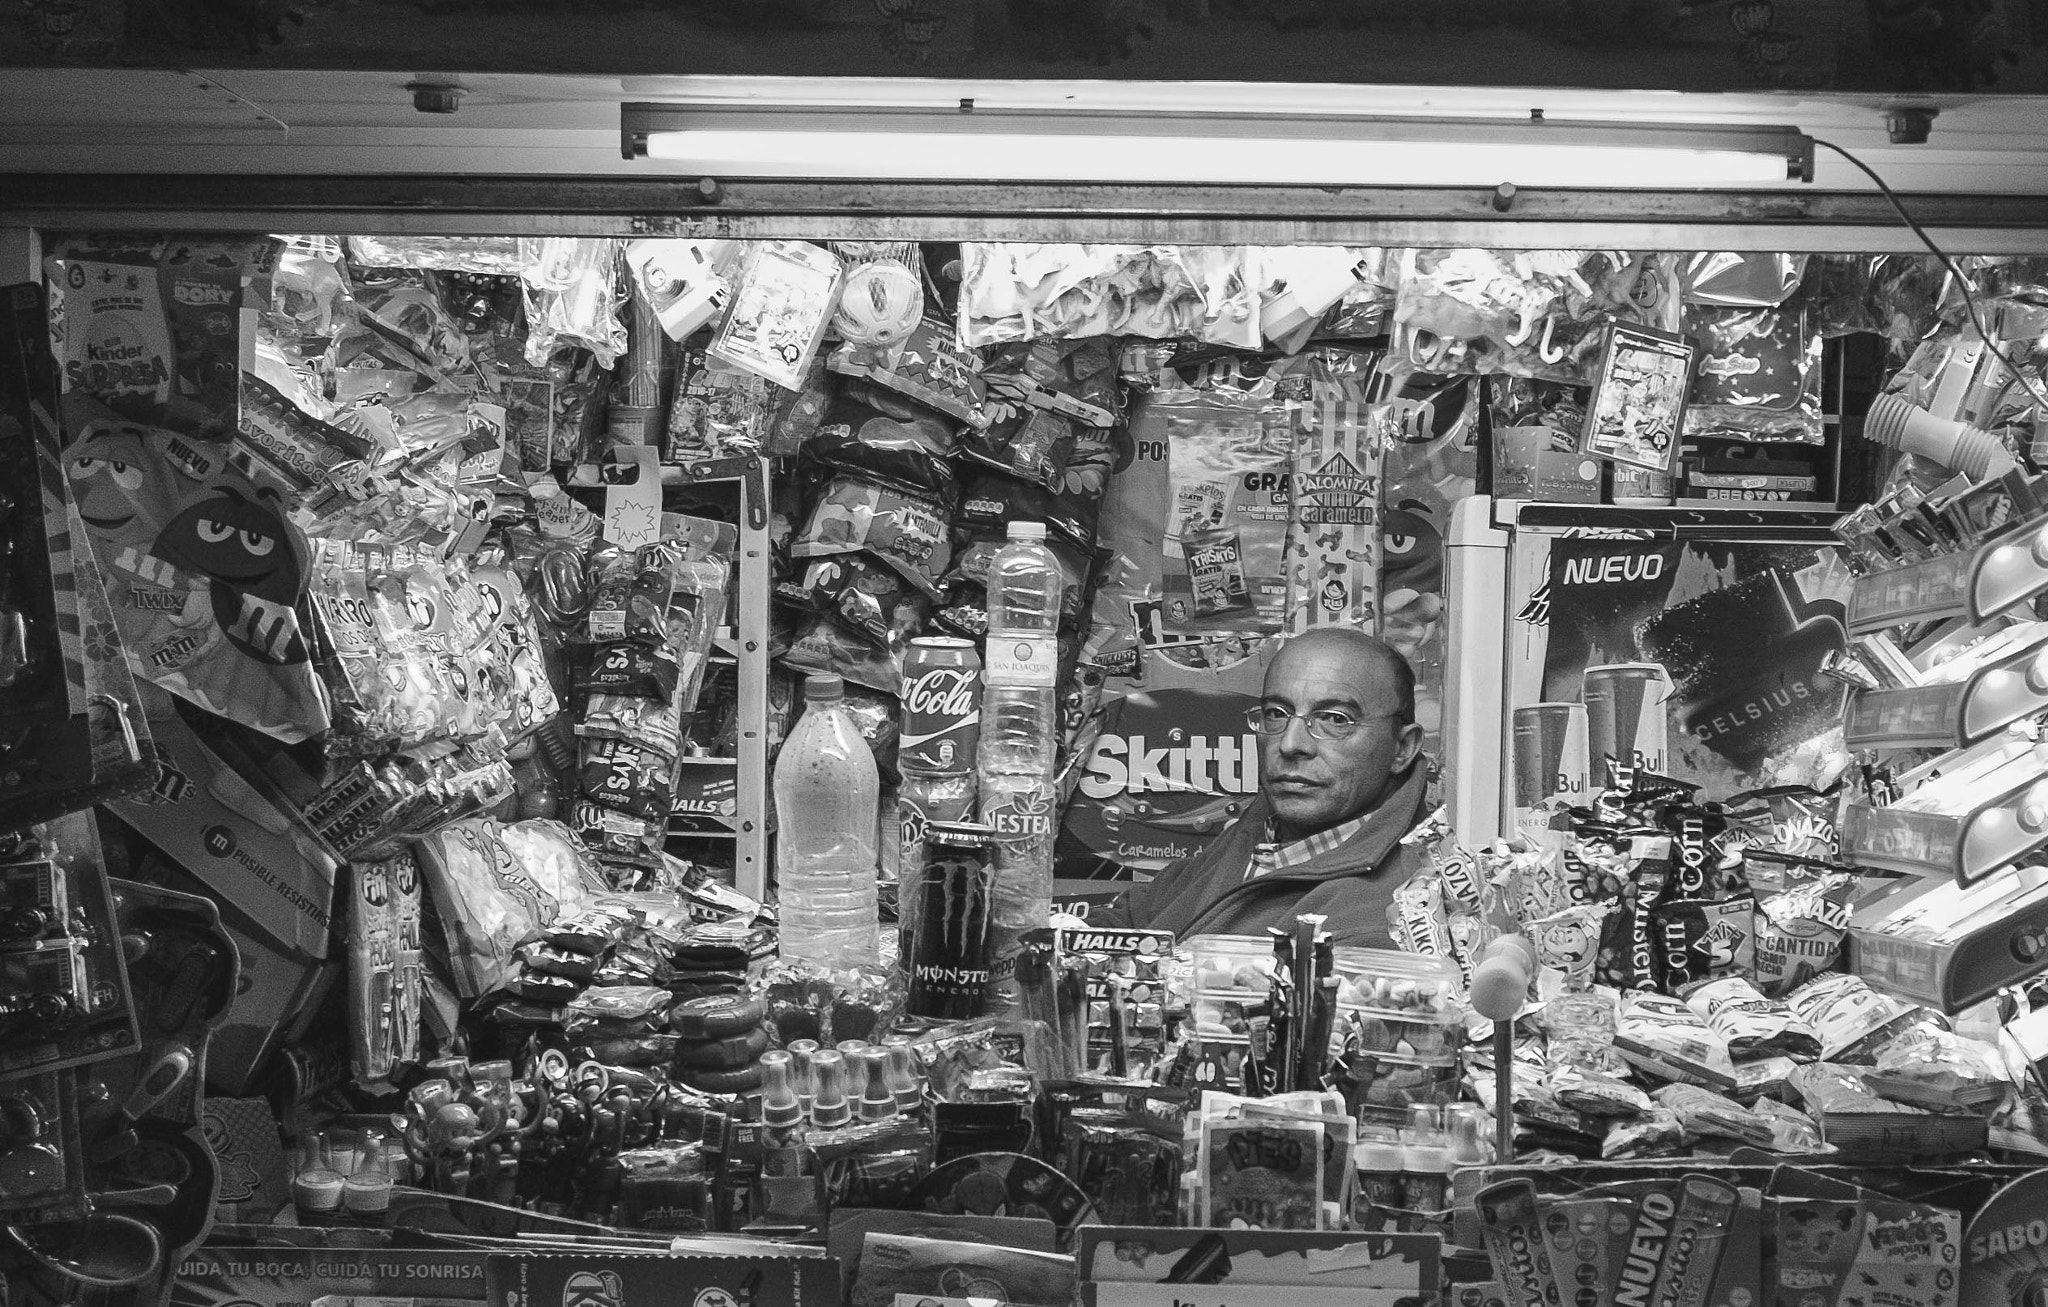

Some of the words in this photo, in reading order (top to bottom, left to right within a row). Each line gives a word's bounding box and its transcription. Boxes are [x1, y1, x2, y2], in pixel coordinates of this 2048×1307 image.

[175, 285, 236, 303] DORY
[88, 344, 143, 361] kinder
[167, 437, 211, 475] NUEVO
[241, 417, 327, 486] avoritos
[1293, 472, 1381, 496] PALOMITAS
[1613, 470, 1639, 484] bit
[902, 510, 941, 540] MNTEQUILLA
[1301, 505, 1373, 524] caramelo
[1191, 546, 1237, 568] TRISKYS
[1563, 553, 1664, 585] NUEVO
[132, 587, 185, 610] TWIX
[1695, 680, 1811, 742] CELSIUS
[1633, 750, 1665, 772] Bull
[1557, 773, 1588, 794] Bull
[984, 811, 1051, 835] NESTEA
[1119, 842, 1187, 859] Caramelos
[1073, 933, 1140, 951] HALLS
[1615, 1193, 1675, 1307] NUEVO
[229, 1262, 251, 1277] TU
[255, 1262, 312, 1280] BOCA,
[316, 1262, 373, 1278] CUIDA
[377, 1263, 400, 1278] TU
[405, 1264, 484, 1279] SONRISA
